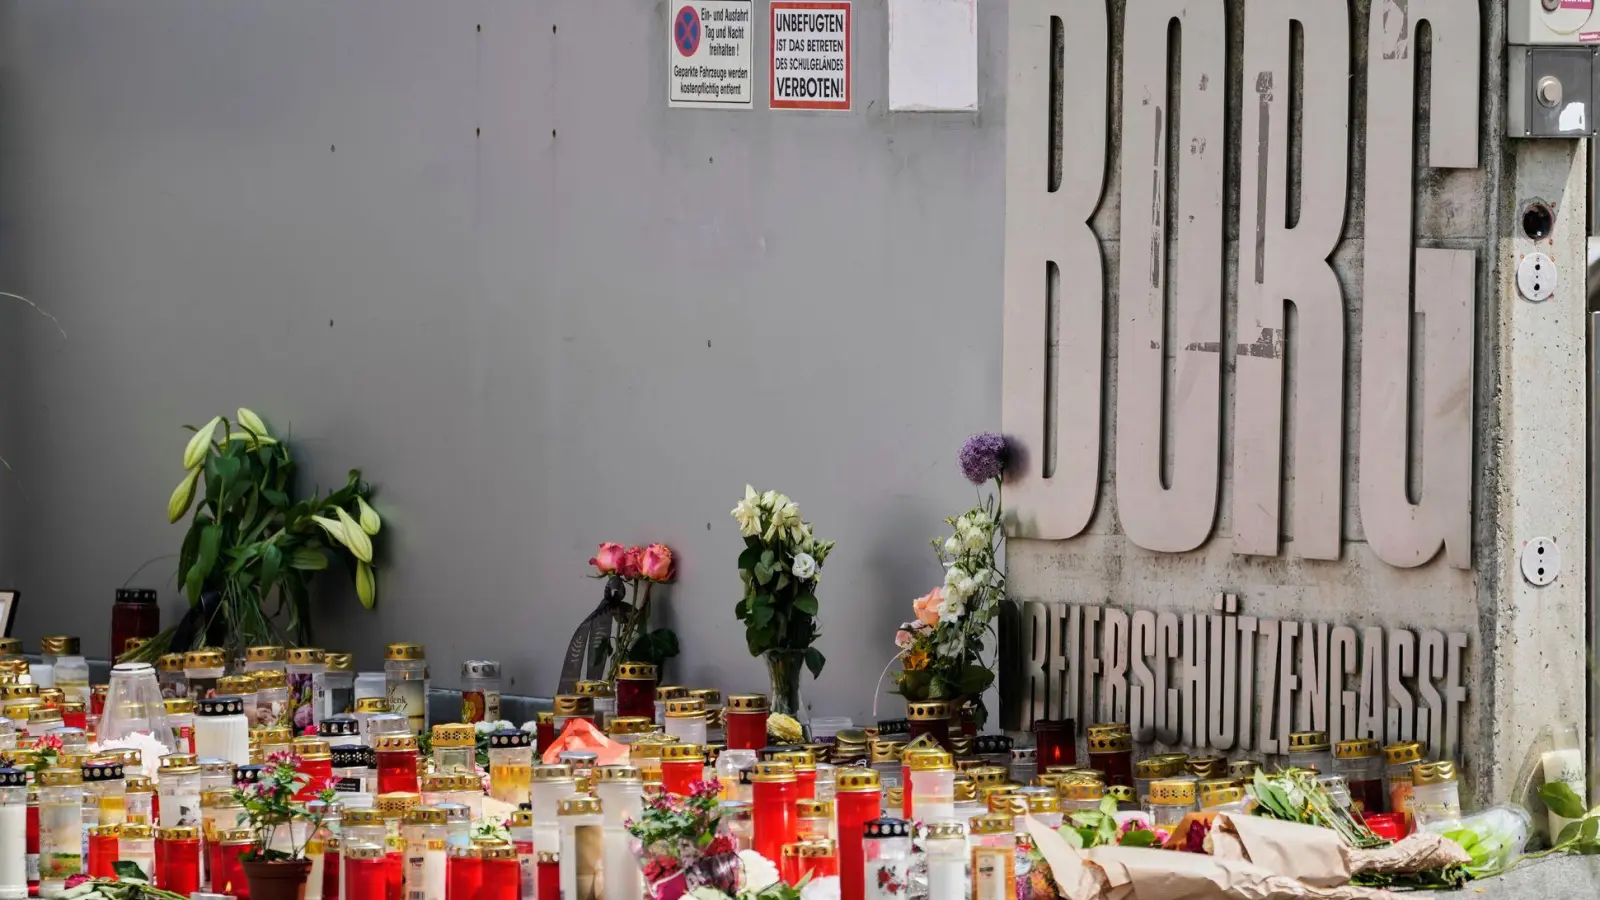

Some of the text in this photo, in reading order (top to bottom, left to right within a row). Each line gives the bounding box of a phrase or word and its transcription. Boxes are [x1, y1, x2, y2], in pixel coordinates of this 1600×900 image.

[701, 8, 749, 22] Ein- und Ausfahrt
[776, 14, 843, 33] UNBEFUGTEN
[705, 25, 744, 41] Tag und Nacht
[709, 43, 736, 56] freihalten
[776, 39, 843, 52] IST DAS BETRETEN
[776, 56, 844, 71] DES SCHULGELÄNDES
[674, 65, 748, 81] Geparkte Fahrzeuge werden
[680, 82, 741, 97] kostenpflichtig entfernt
[776, 77, 844, 98] VERBOTEN!
[1000, 0, 1480, 570] BORG
